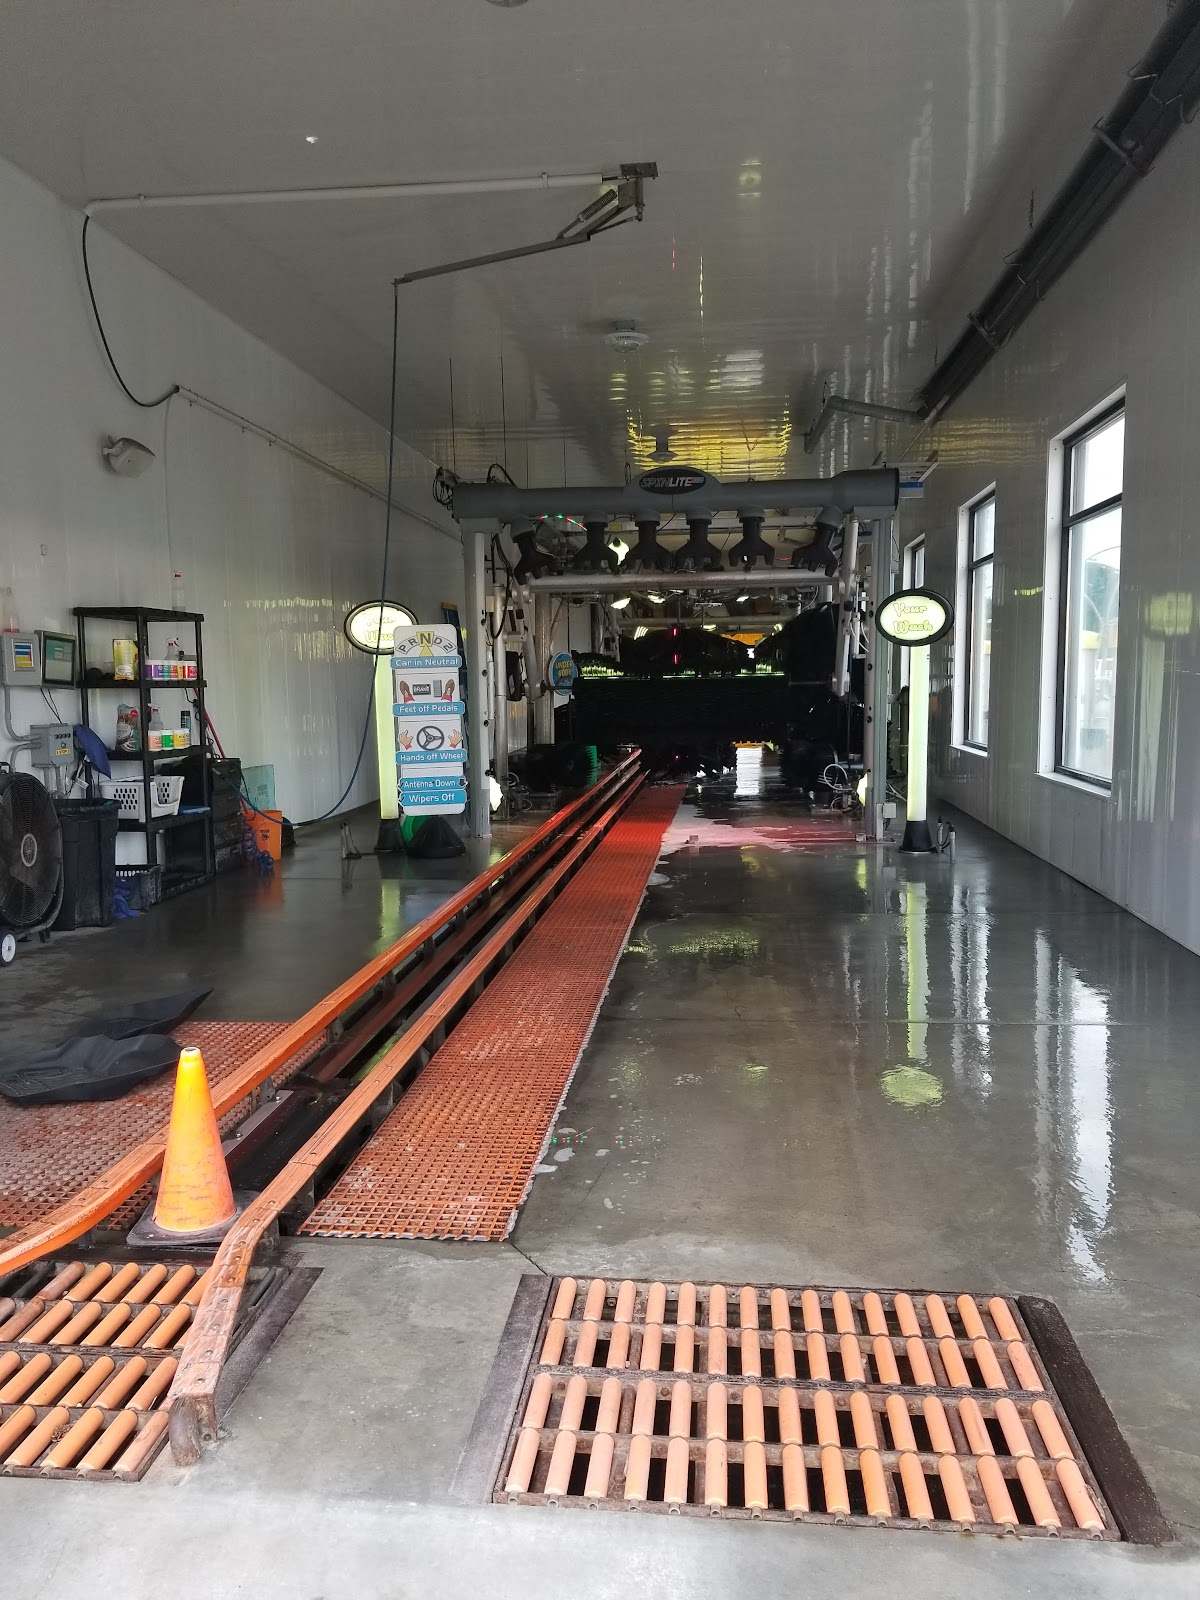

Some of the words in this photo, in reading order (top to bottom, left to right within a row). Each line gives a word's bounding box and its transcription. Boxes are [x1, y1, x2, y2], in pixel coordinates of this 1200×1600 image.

[420, 632, 431, 644] N
[396, 659, 412, 667] Car
[414, 658, 423, 666] in
[424, 657, 458, 666] Neutral
[400, 705, 417, 713] Feet
[418, 704, 430, 713] off
[432, 704, 458, 712] Pedals
[440, 752, 464, 760] Wheel
[404, 780, 434, 788] Antenna
[435, 779, 456, 788] Down
[408, 794, 440, 804] Wipers
[441, 793, 456, 802] Off
